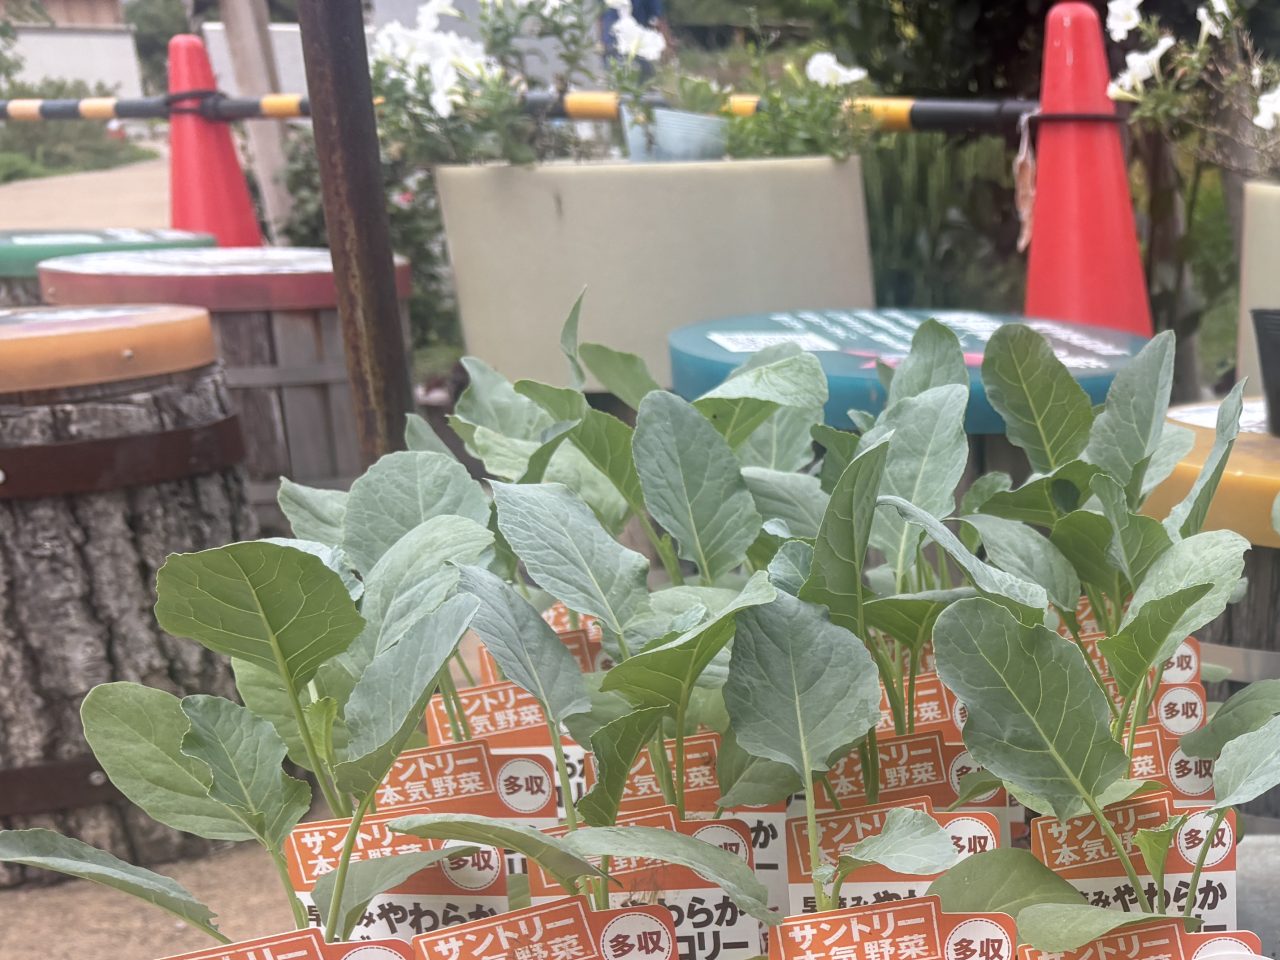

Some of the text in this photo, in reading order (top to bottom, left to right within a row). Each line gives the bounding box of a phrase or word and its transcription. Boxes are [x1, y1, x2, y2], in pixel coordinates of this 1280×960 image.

[439, 689, 534, 716] ントリー
[1164, 702, 1199, 720] 多収
[444, 704, 543, 738] 気野菜
[1174, 759, 1213, 778] 多収
[376, 771, 485, 805] 本気野菜
[503, 775, 547, 795] 多収
[1184, 828, 1227, 850] 多収
[609, 930, 665, 958] 多収
[789, 912, 925, 950] サントリー
